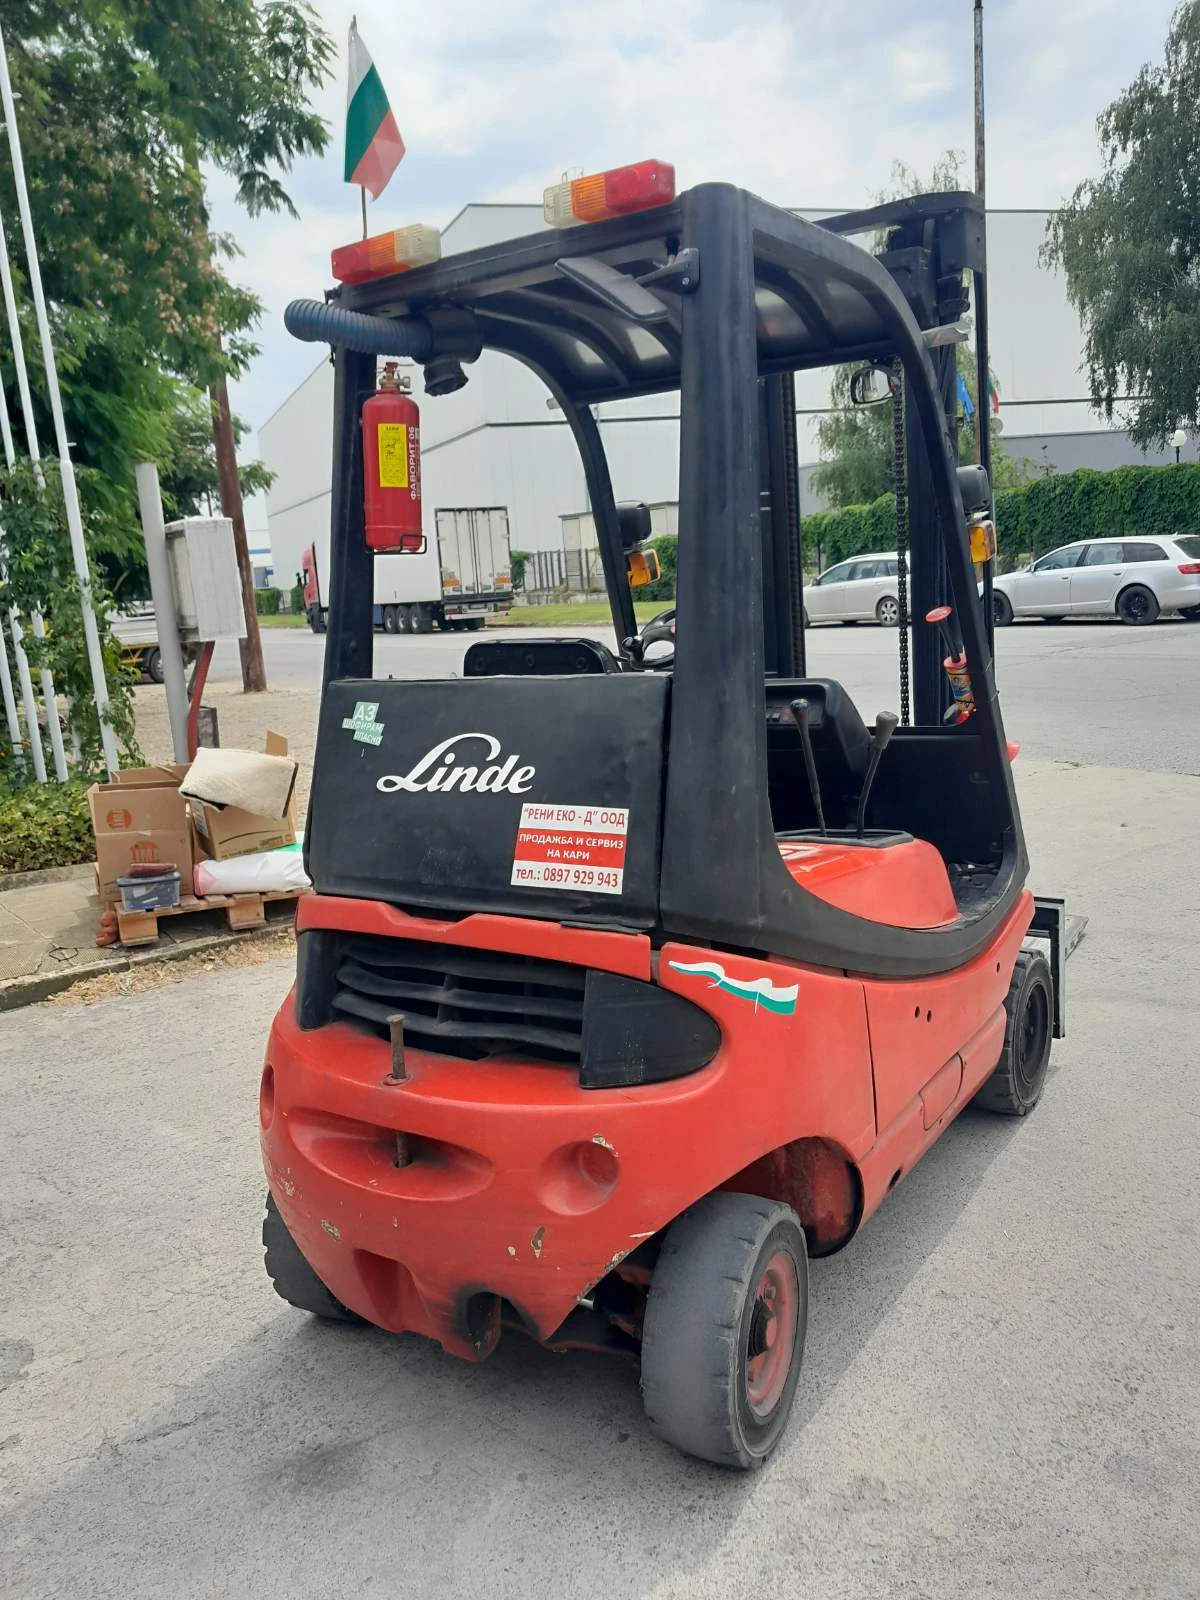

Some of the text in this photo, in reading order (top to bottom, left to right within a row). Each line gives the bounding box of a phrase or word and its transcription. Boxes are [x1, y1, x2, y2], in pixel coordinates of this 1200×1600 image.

[408, 442, 417, 501] ФАВОРИТ
[354, 731, 382, 745] ОПАСНО
[376, 732, 536, 794] Linde
[556, 809, 576, 822] ЕКО
[600, 811, 625, 828] ООД
[519, 833, 624, 849] ПРОДАЖБА И СЕРВИЗ
[546, 848, 590, 860] НА КАРИ
[515, 867, 619, 888] тел.: 0897 929 943
